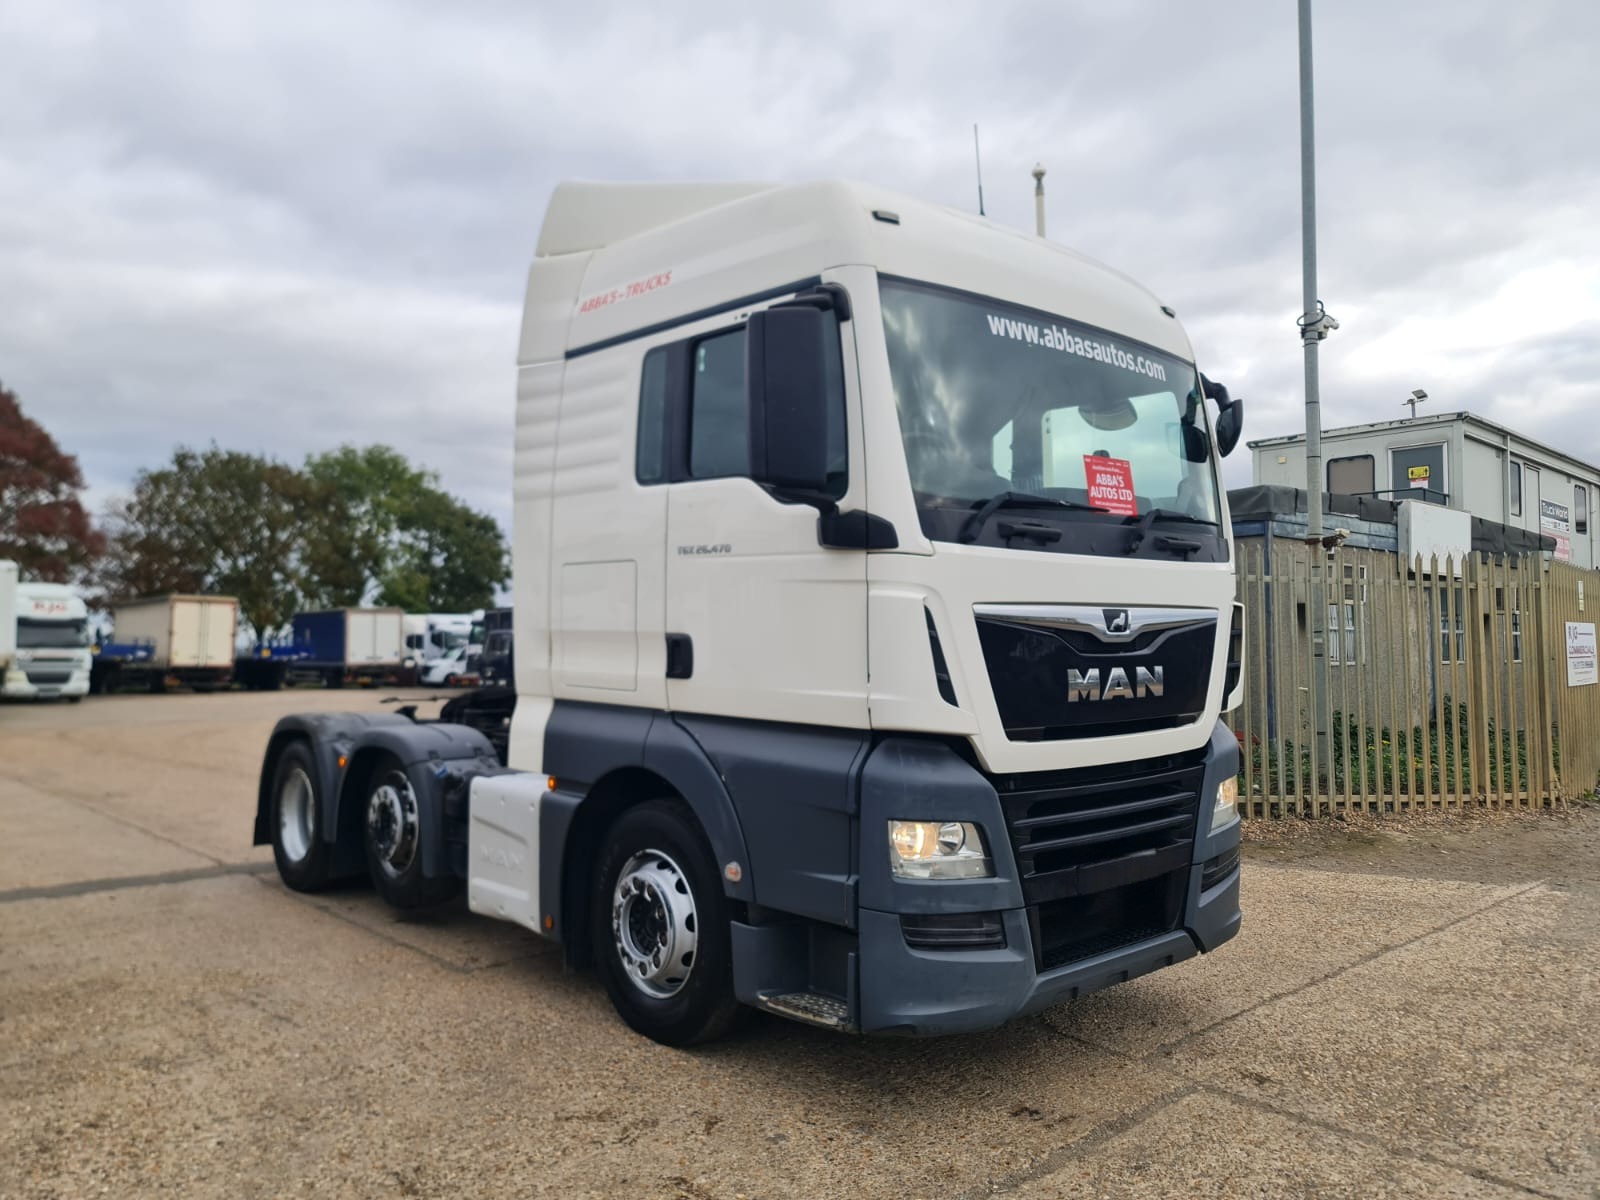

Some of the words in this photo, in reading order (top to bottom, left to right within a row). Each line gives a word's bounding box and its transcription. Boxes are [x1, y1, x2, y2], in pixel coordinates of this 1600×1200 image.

[987, 314, 1166, 382] www.abbasautos.com
[1096, 473, 1125, 488] ABBA'S
[1090, 486, 1118, 500] AUTOS
[1118, 489, 1133, 502] LTD
[1067, 665, 1164, 702] MAN
